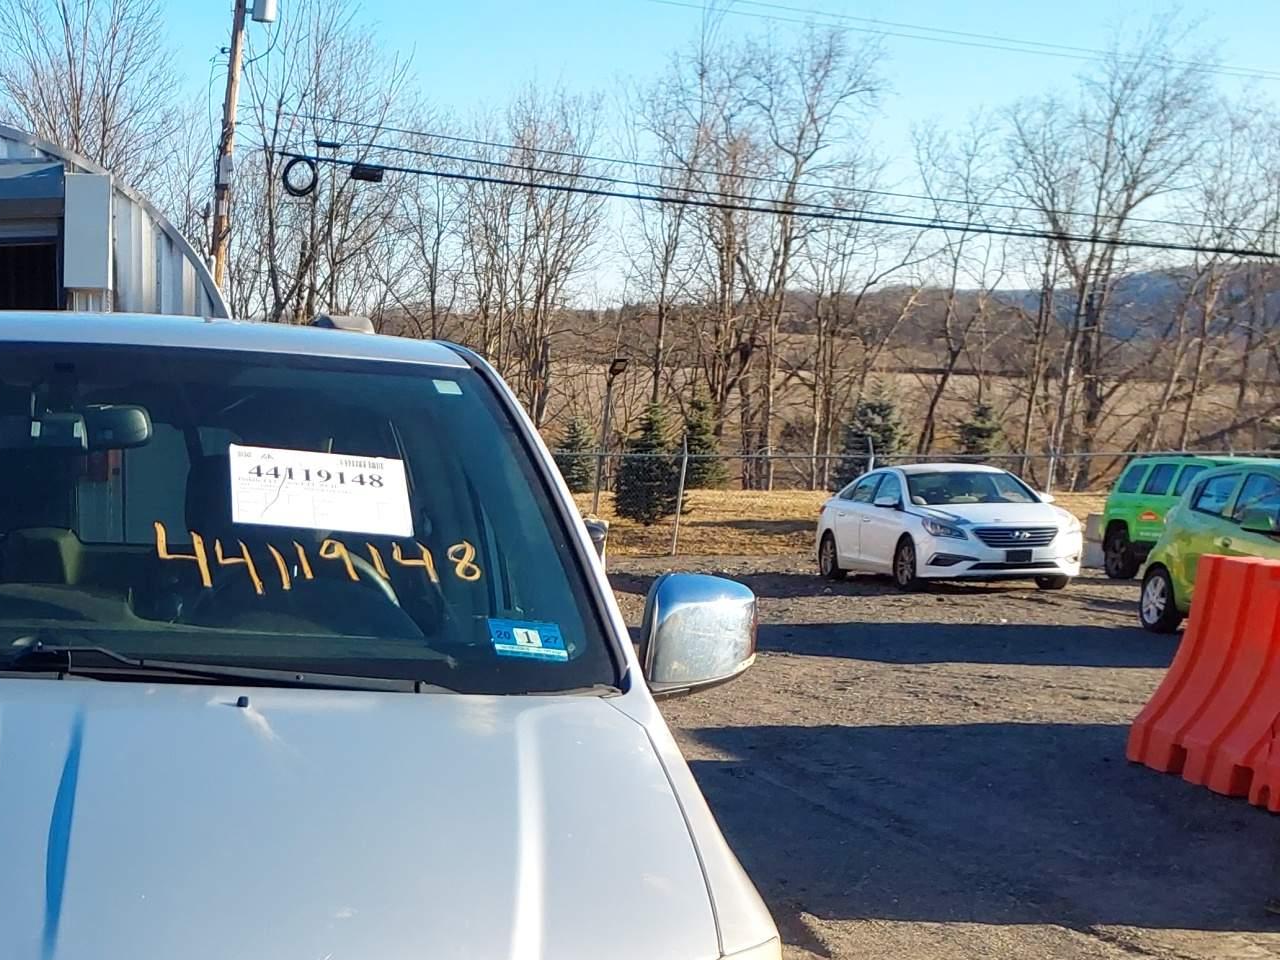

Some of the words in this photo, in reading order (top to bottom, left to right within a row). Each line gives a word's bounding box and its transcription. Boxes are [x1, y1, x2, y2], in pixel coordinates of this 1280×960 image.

[248, 464, 385, 489] 44119148
[154, 521, 482, 596] 44119148
[495, 629, 511, 640] 20
[523, 630, 535, 644] 1
